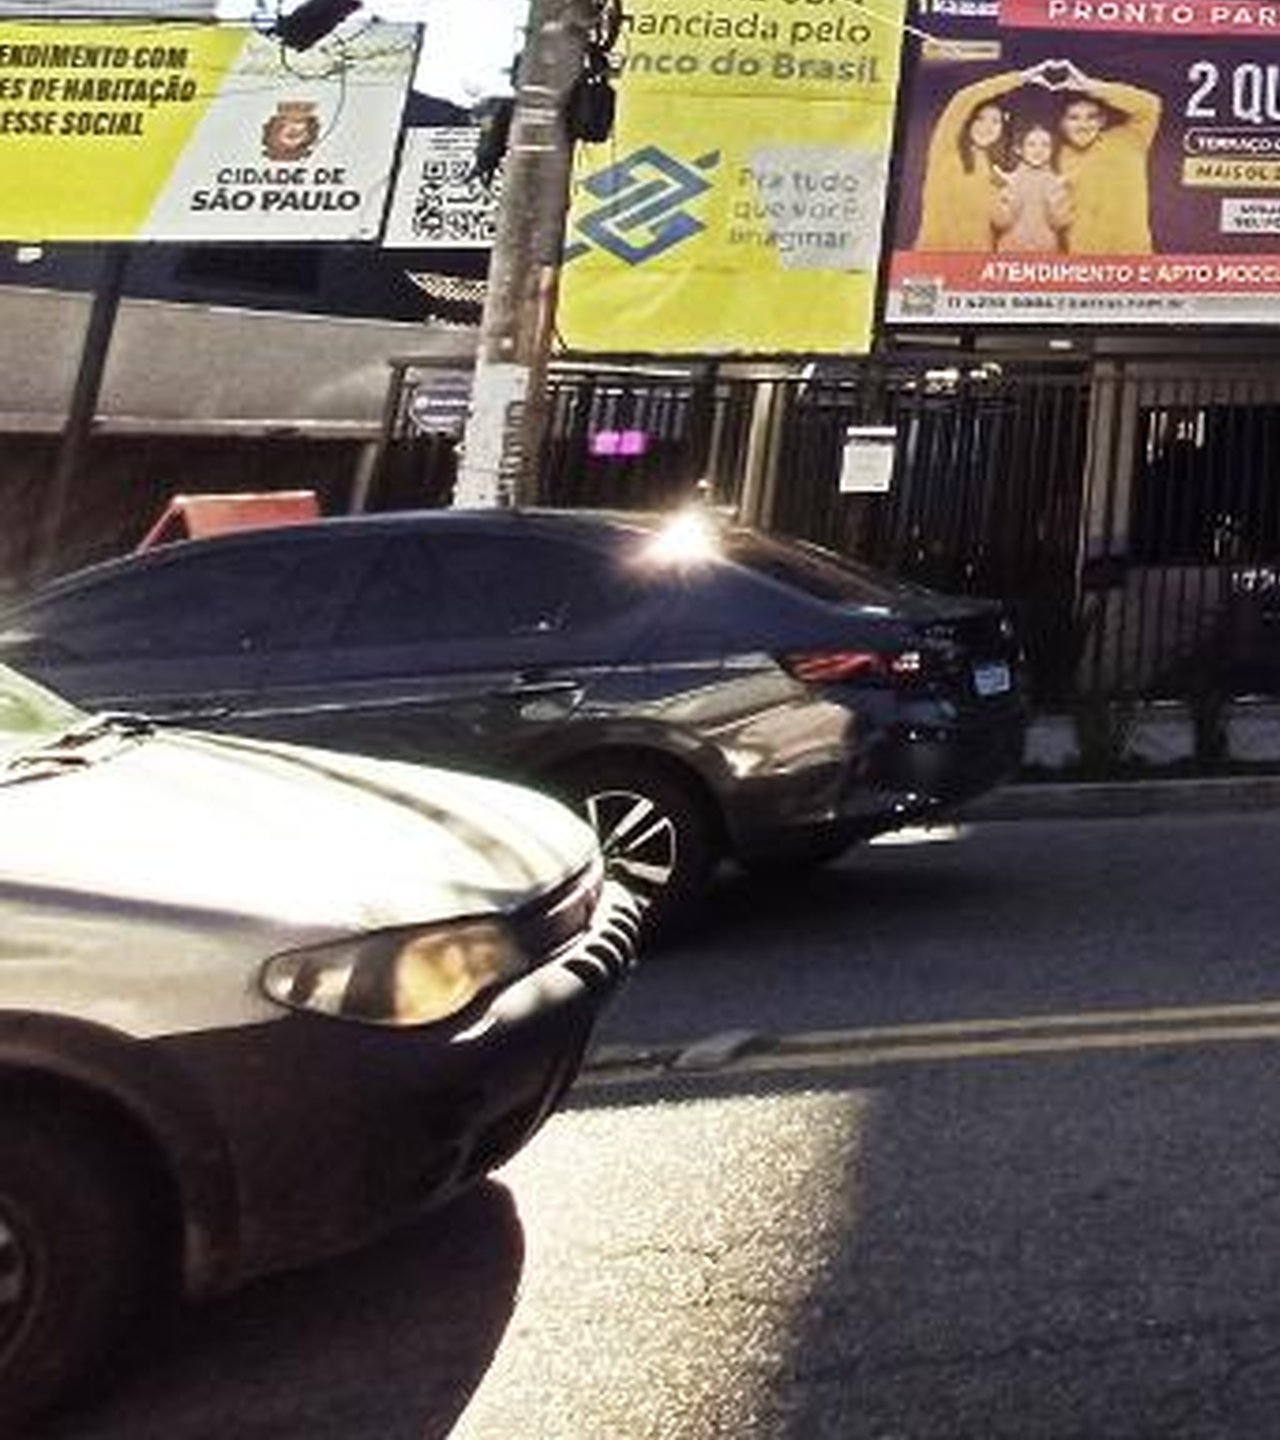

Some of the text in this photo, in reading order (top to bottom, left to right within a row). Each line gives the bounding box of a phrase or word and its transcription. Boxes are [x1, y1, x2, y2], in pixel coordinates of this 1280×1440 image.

[1049, 0, 1194, 24] PRONTO
[620, 12, 872, 46] nanciada pelo
[133, 47, 188, 69] COM
[711, 49, 760, 76] do
[772, 53, 880, 83] Brasil
[28, 78, 60, 101] DE
[62, 75, 197, 108] HABITAÇÃO
[1185, 59, 1219, 118] 2
[59, 111, 144, 136] SOCIAL
[217, 168, 346, 185] CIDADE DE
[791, 171, 860, 192] tudo
[1196, 164, 1243, 180] MAIS
[190, 188, 361, 211] SÃO PAULO
[981, 262, 1133, 282] ATENDIMENTO
[1155, 264, 1212, 283] APTO
